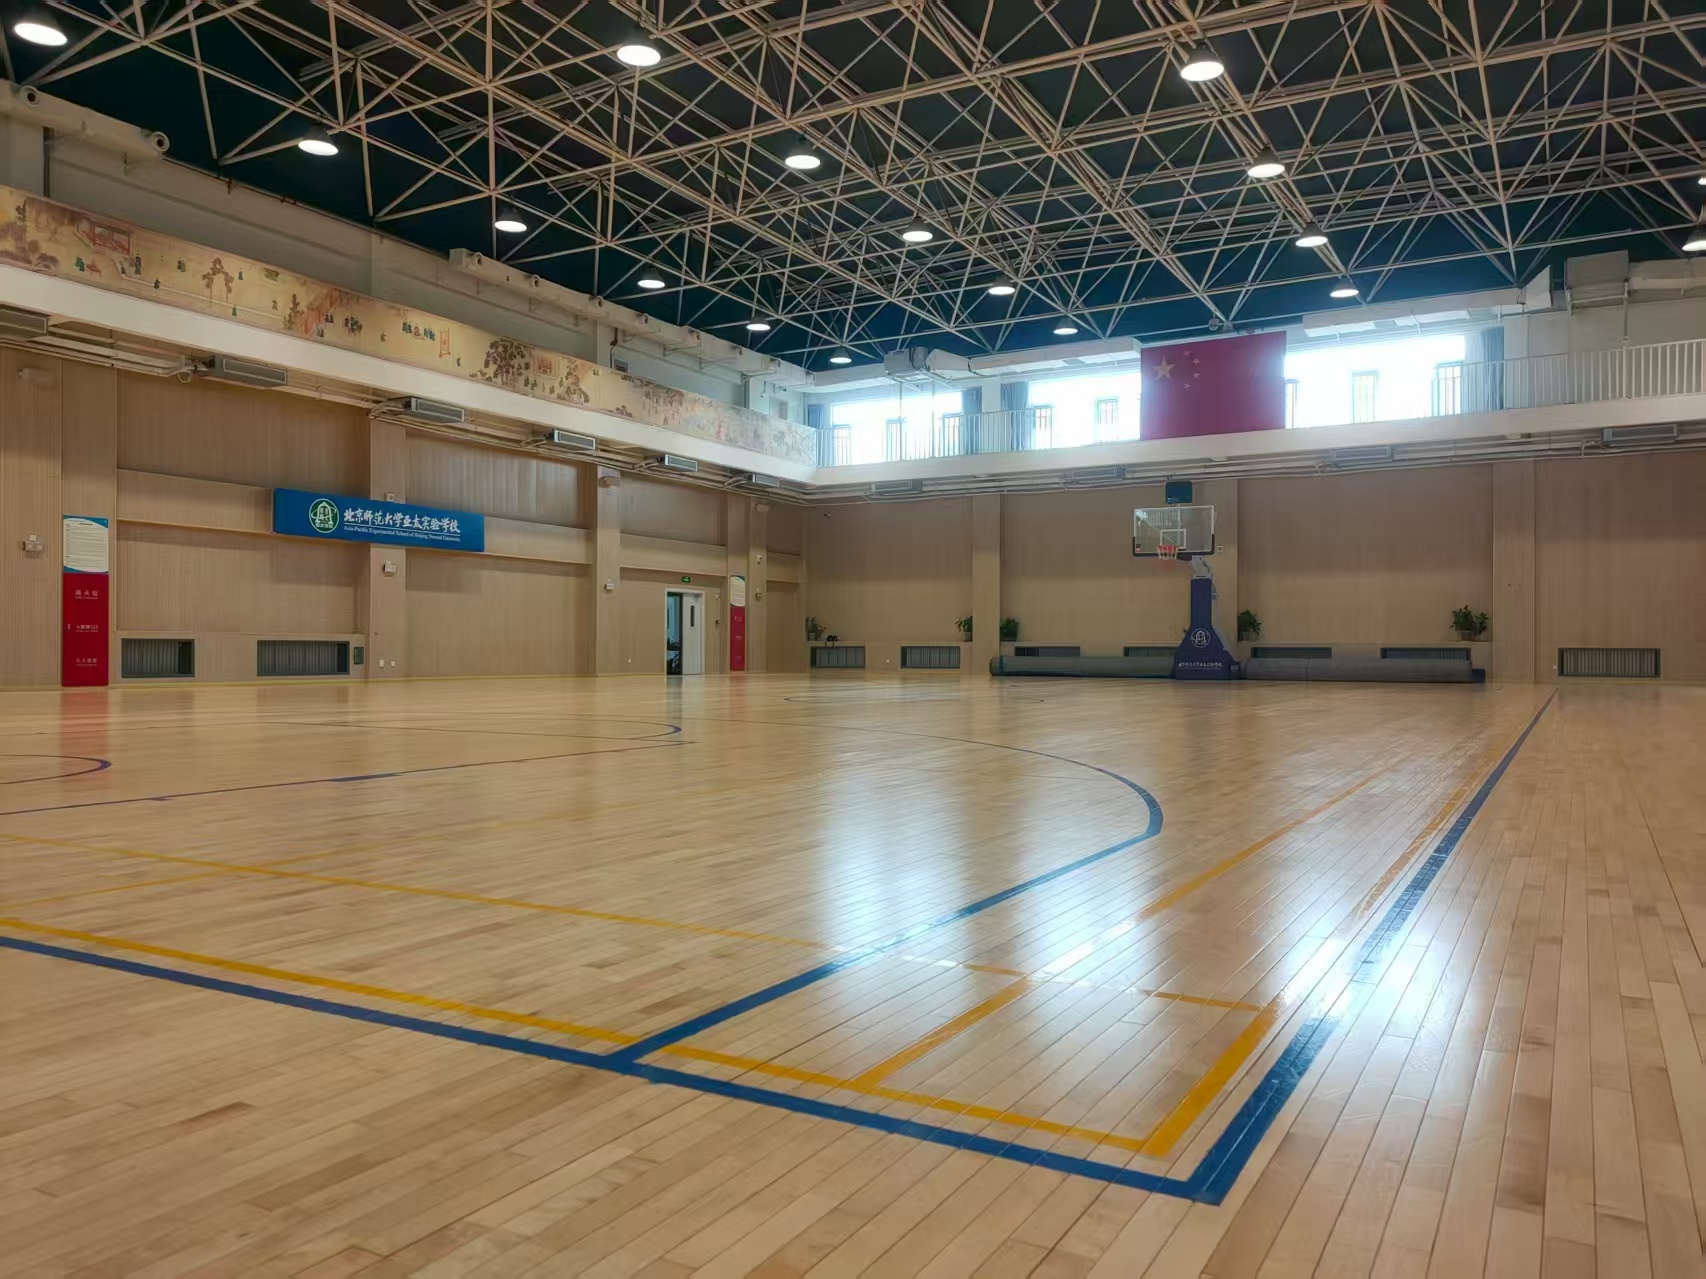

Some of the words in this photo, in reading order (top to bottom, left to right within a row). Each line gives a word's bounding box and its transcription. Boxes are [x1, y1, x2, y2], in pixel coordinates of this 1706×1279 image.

[344, 507, 460, 533] 北京师范大学亚太实验学校
